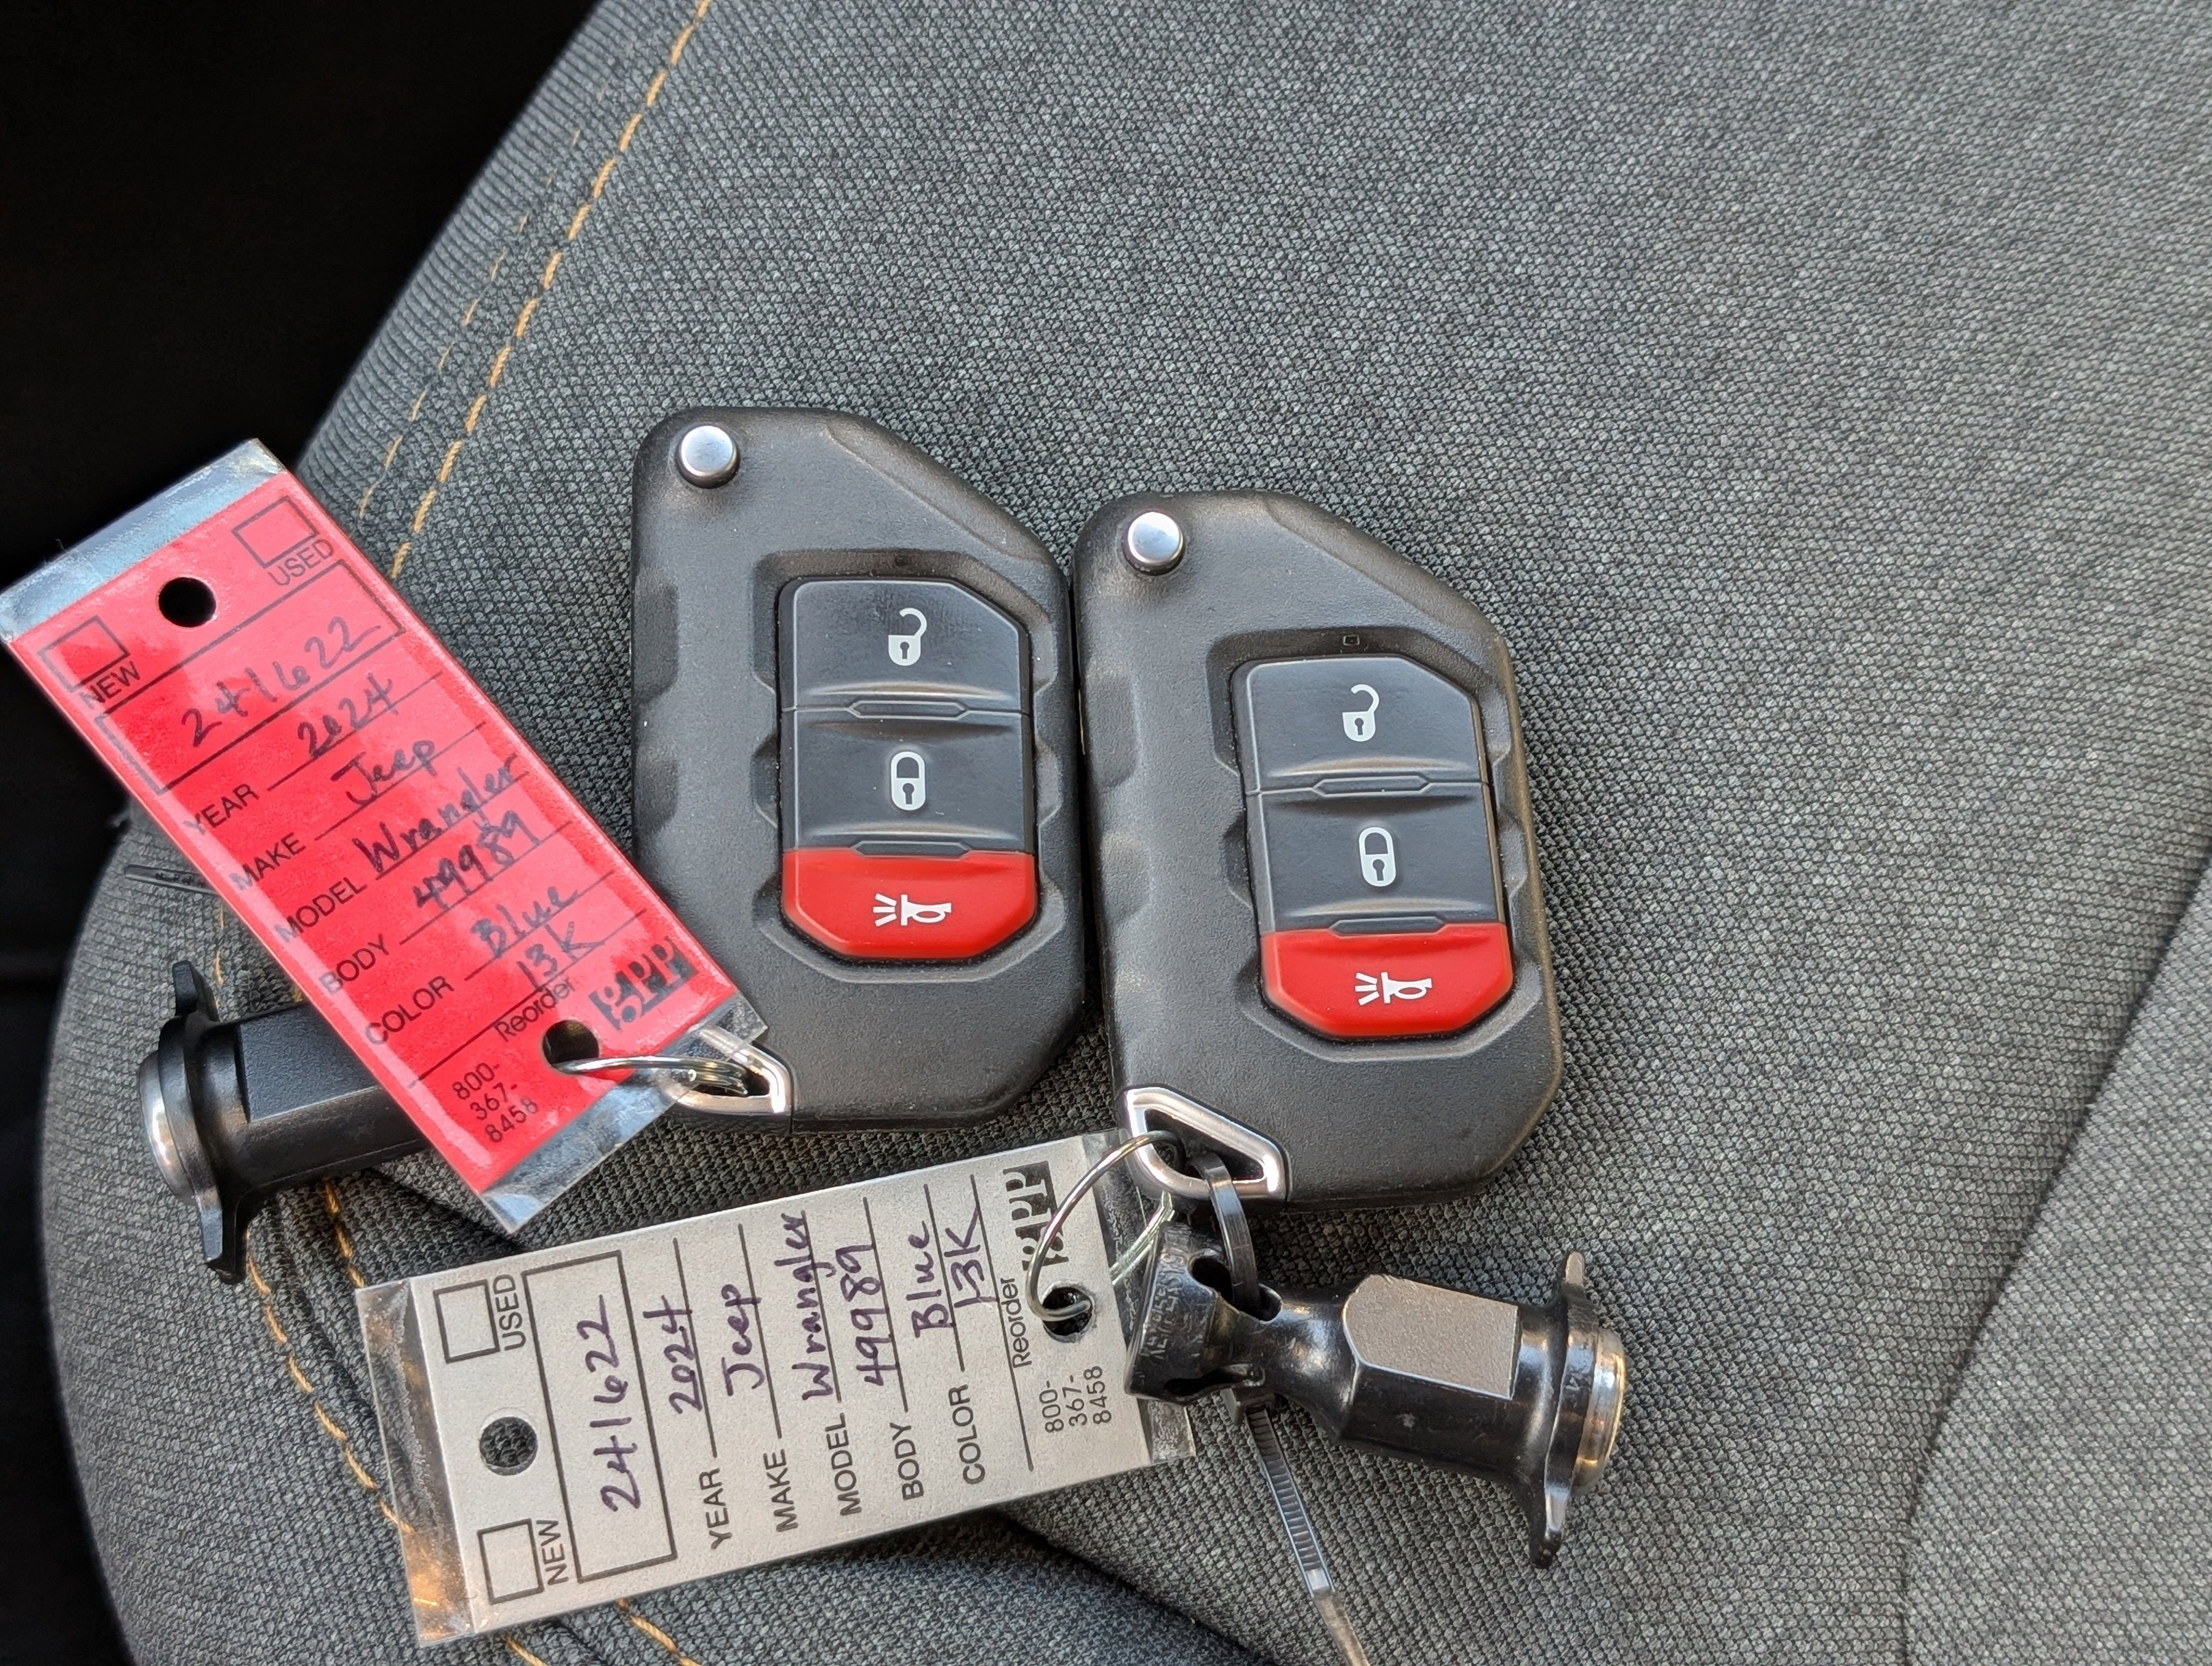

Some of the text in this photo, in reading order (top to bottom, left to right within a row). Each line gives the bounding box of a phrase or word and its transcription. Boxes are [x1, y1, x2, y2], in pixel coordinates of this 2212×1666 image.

[268, 538, 335, 586] USED
[79, 661, 141, 708] NEW
[181, 616, 381, 748] 241622
[298, 671, 399, 758] 2024
[184, 783, 260, 836] YEAR
[331, 740, 436, 806] Jeep
[352, 752, 518, 872] Wrangler
[229, 832, 307, 891] MAKE
[413, 811, 541, 911] 49989
[274, 876, 368, 943] MODEL
[471, 886, 580, 959] Blue
[319, 934, 390, 995] BODY
[517, 921, 603, 990] 13K
[364, 975, 455, 1045] COLOR
[494, 977, 576, 1042] Reorder
[452, 1062, 501, 1101] 800-
[470, 1086, 517, 1122] 367-
[485, 1097, 538, 1143] 8458
[905, 1220, 955, 1337] Blue
[943, 1206, 1000, 1309] 13K
[493, 1273, 526, 1351] USED
[719, 1284, 766, 1397] Jeep
[774, 1212, 838, 1401] Wrangler
[835, 1243, 899, 1386] 49989
[999, 1277, 1033, 1369] Reorder
[644, 1295, 703, 1414] 2024
[576, 1295, 641, 1513] 241622
[1039, 1379, 1064, 1433] 800-
[1067, 1374, 1087, 1427] 367-
[1082, 1365, 1111, 1424] 8458
[825, 1412, 863, 1516] MODEL
[889, 1421, 924, 1501] BODY
[948, 1383, 986, 1485] COLOR
[699, 1468, 732, 1549] YEAR
[763, 1448, 799, 1533] MAKE
[538, 1519, 569, 1586] NEW
